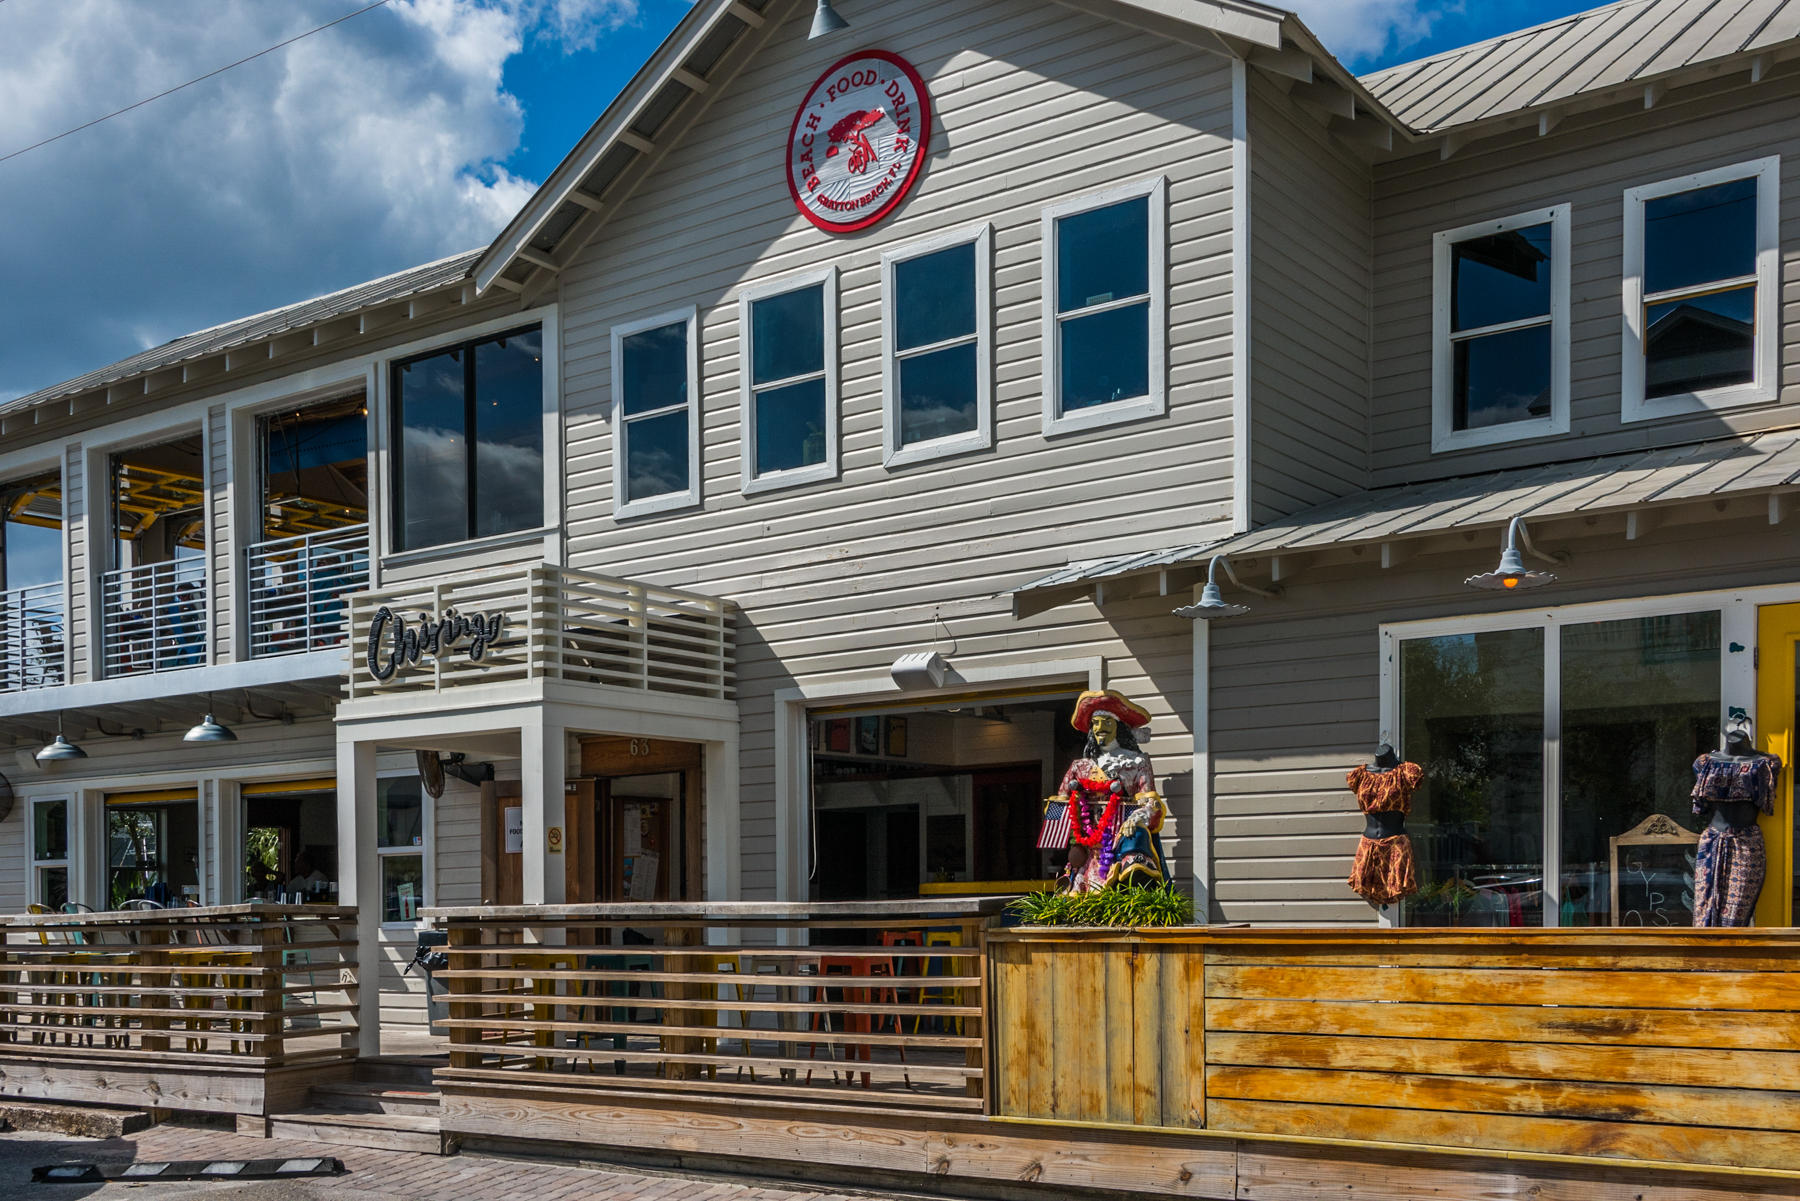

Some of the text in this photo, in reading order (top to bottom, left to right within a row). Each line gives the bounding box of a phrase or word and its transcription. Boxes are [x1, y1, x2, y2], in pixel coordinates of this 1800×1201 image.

[801, 69, 911, 193] BEACH FOOD DRINK
[816, 193, 860, 211] GRAYTON
[887, 161, 902, 178] FL
[629, 738, 650, 757] 63
